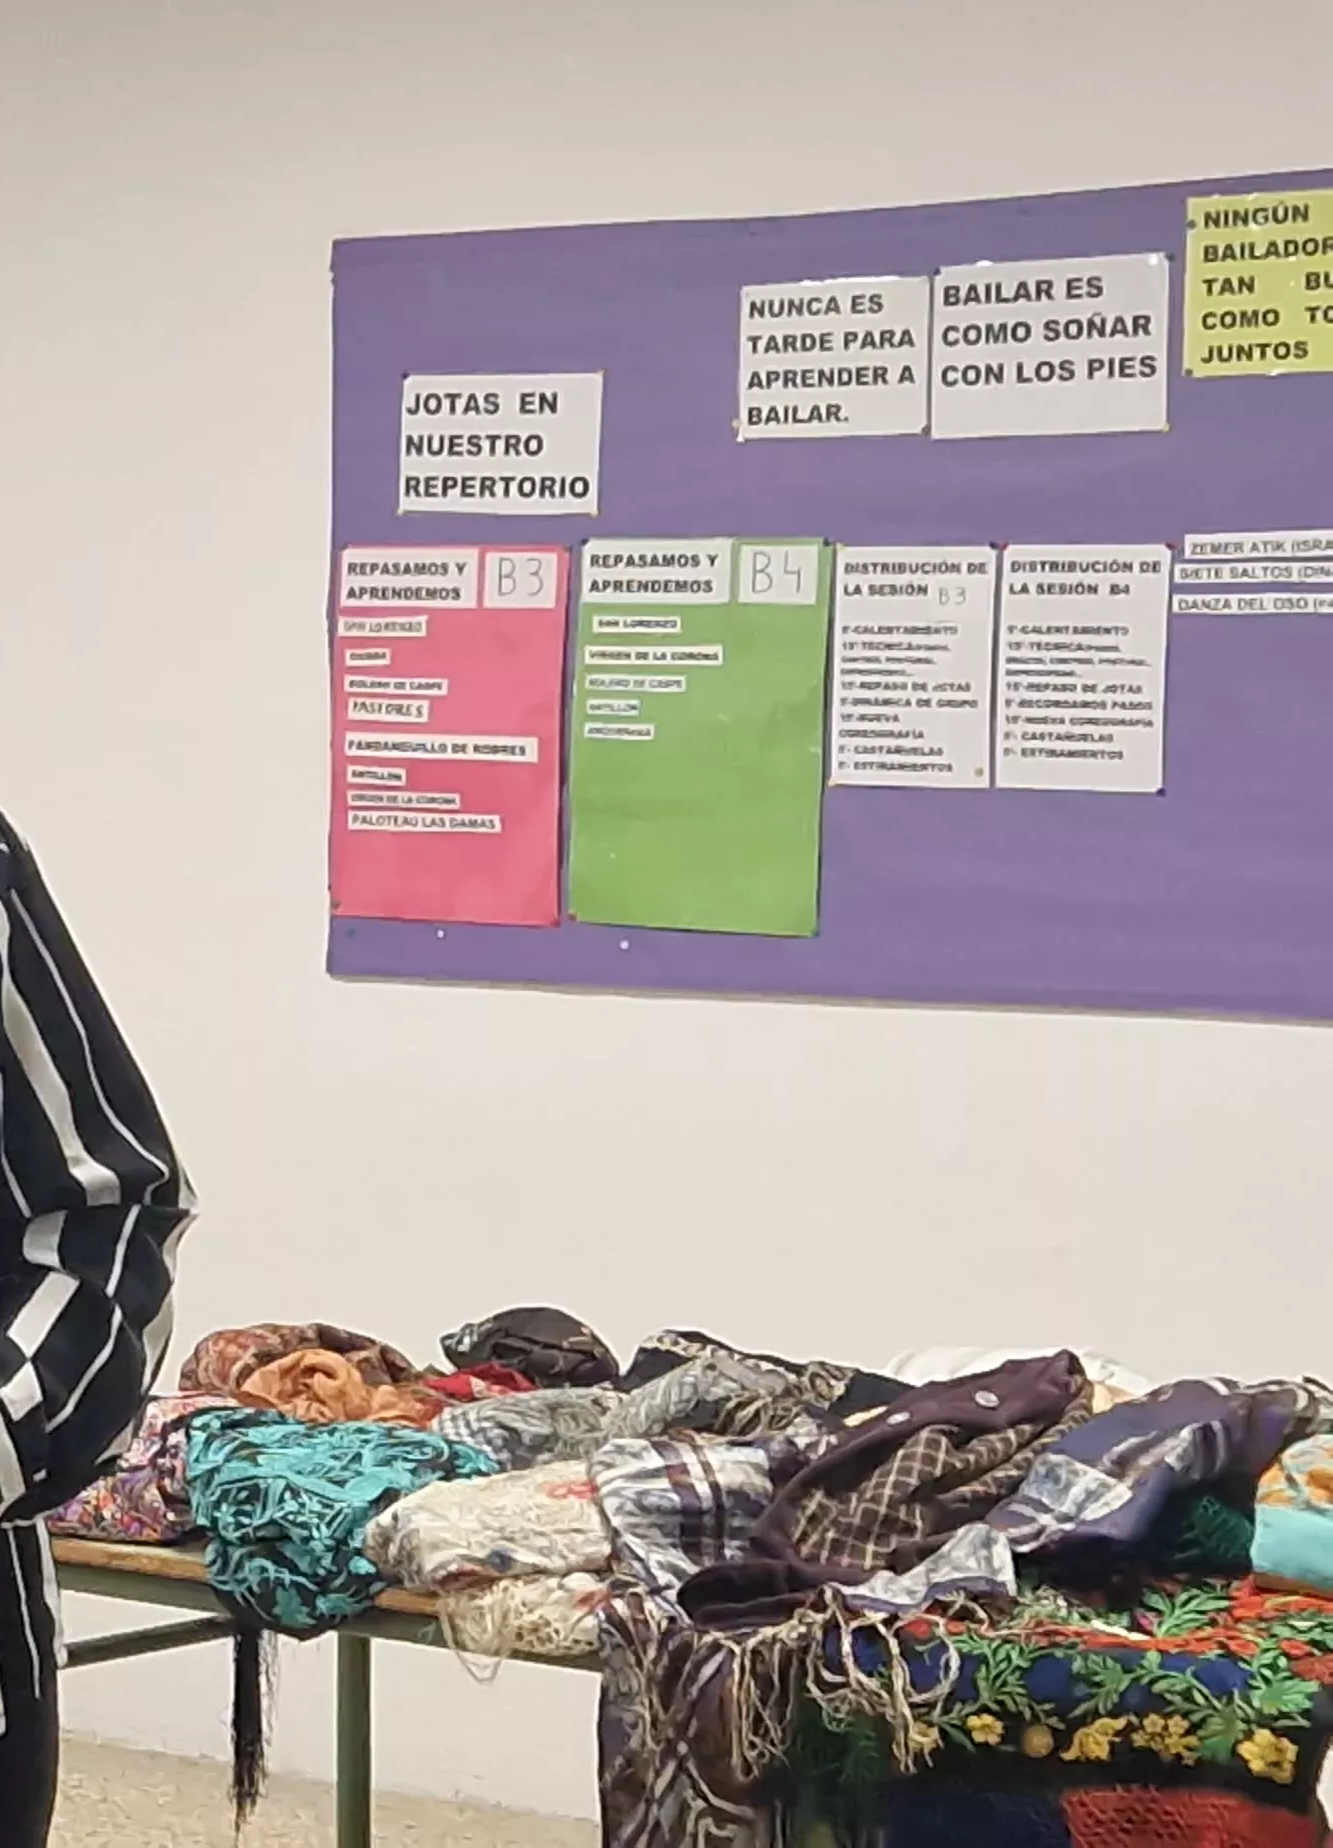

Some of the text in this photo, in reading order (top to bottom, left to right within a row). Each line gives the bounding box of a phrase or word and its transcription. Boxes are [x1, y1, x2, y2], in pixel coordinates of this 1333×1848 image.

[1204, 201, 1310, 229] NINGÚN
[942, 276, 1104, 307] BAILAR ES
[1202, 275, 1255, 297] TAN
[748, 293, 884, 319] NUNCA ES
[941, 312, 1153, 347] COMO SOÑAR
[1201, 307, 1281, 331] COMO
[747, 328, 917, 355] TARDE PARA
[1201, 340, 1309, 364] JUNTOS
[746, 365, 916, 391] APRENDER A
[940, 354, 1158, 388] CON LOS PIES
[405, 392, 558, 415] JOTAS EN
[747, 403, 849, 426] BAILAR.
[405, 434, 544, 456] NUESTRO
[404, 476, 590, 499] REPERTORIO
[1249, 540, 1286, 554] ATIK
[347, 562, 467, 576] REPASAMOS Y
[589, 554, 719, 568] REPASAMOS Y
[844, 558, 988, 575] DISTRIBUCIÓN DE
[1011, 558, 1161, 574] DISTRIBUCIÓN DE
[1230, 566, 1292, 579] SALTOS
[346, 586, 461, 600] APRENDEMOS
[589, 579, 714, 594] APRENDEMOS
[843, 580, 928, 596] LA SESIÓN
[1009, 582, 1030, 595] LA
[1036, 580, 1099, 596] SESIÓN
[1178, 598, 1232, 611] DANZA
[1238, 598, 1270, 611] DEL
